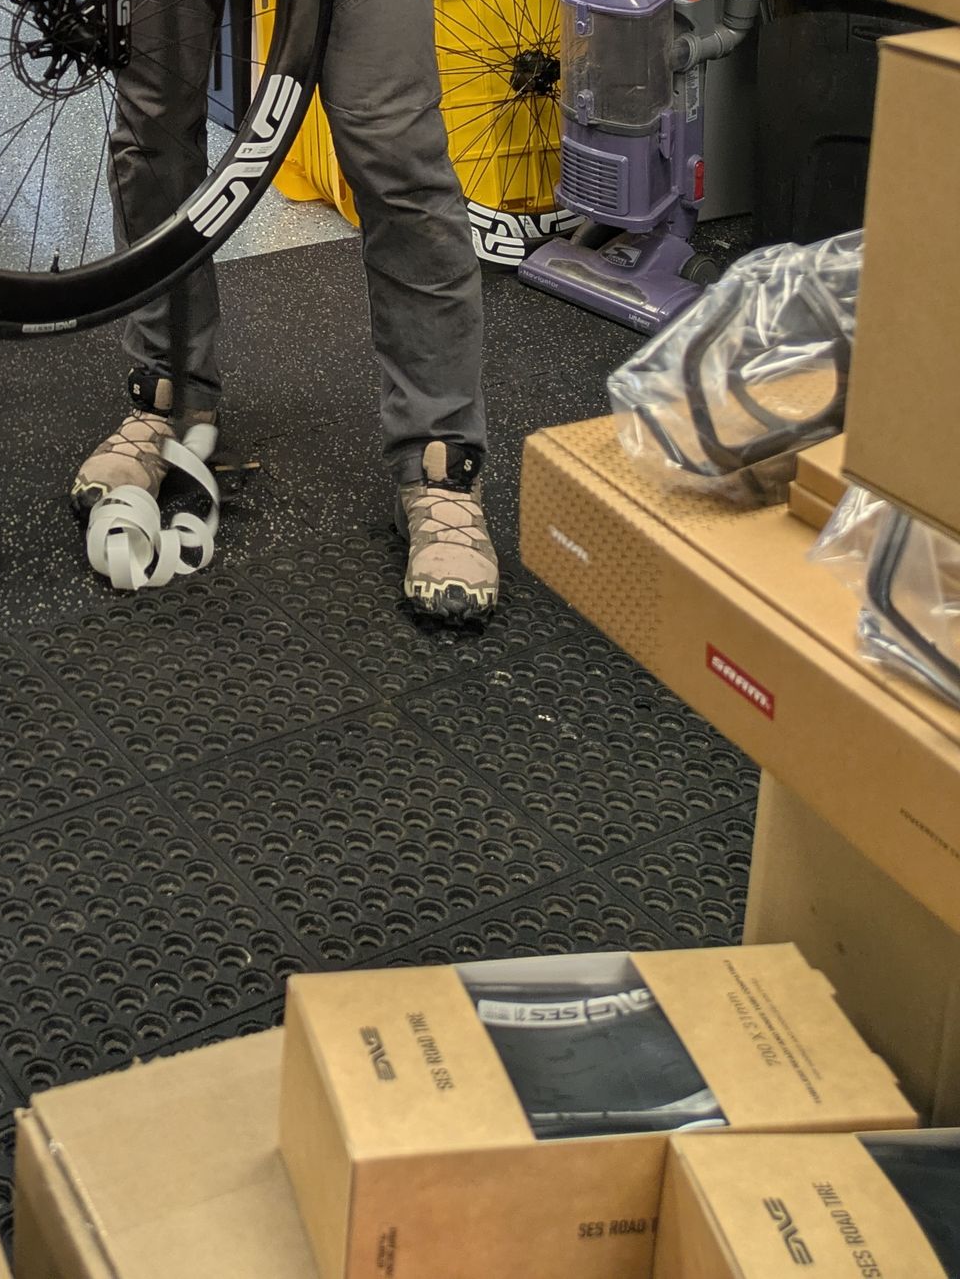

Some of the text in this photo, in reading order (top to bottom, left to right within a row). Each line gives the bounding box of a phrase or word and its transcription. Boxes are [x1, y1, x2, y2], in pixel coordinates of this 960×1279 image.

[711, 655, 770, 709] SRAM
[530, 1006, 580, 1022] SES
[430, 1066, 455, 1092] SES
[813, 1180, 842, 1211] TIRE
[578, 1221, 604, 1238] SES
[830, 1208, 866, 1247] ROAD
